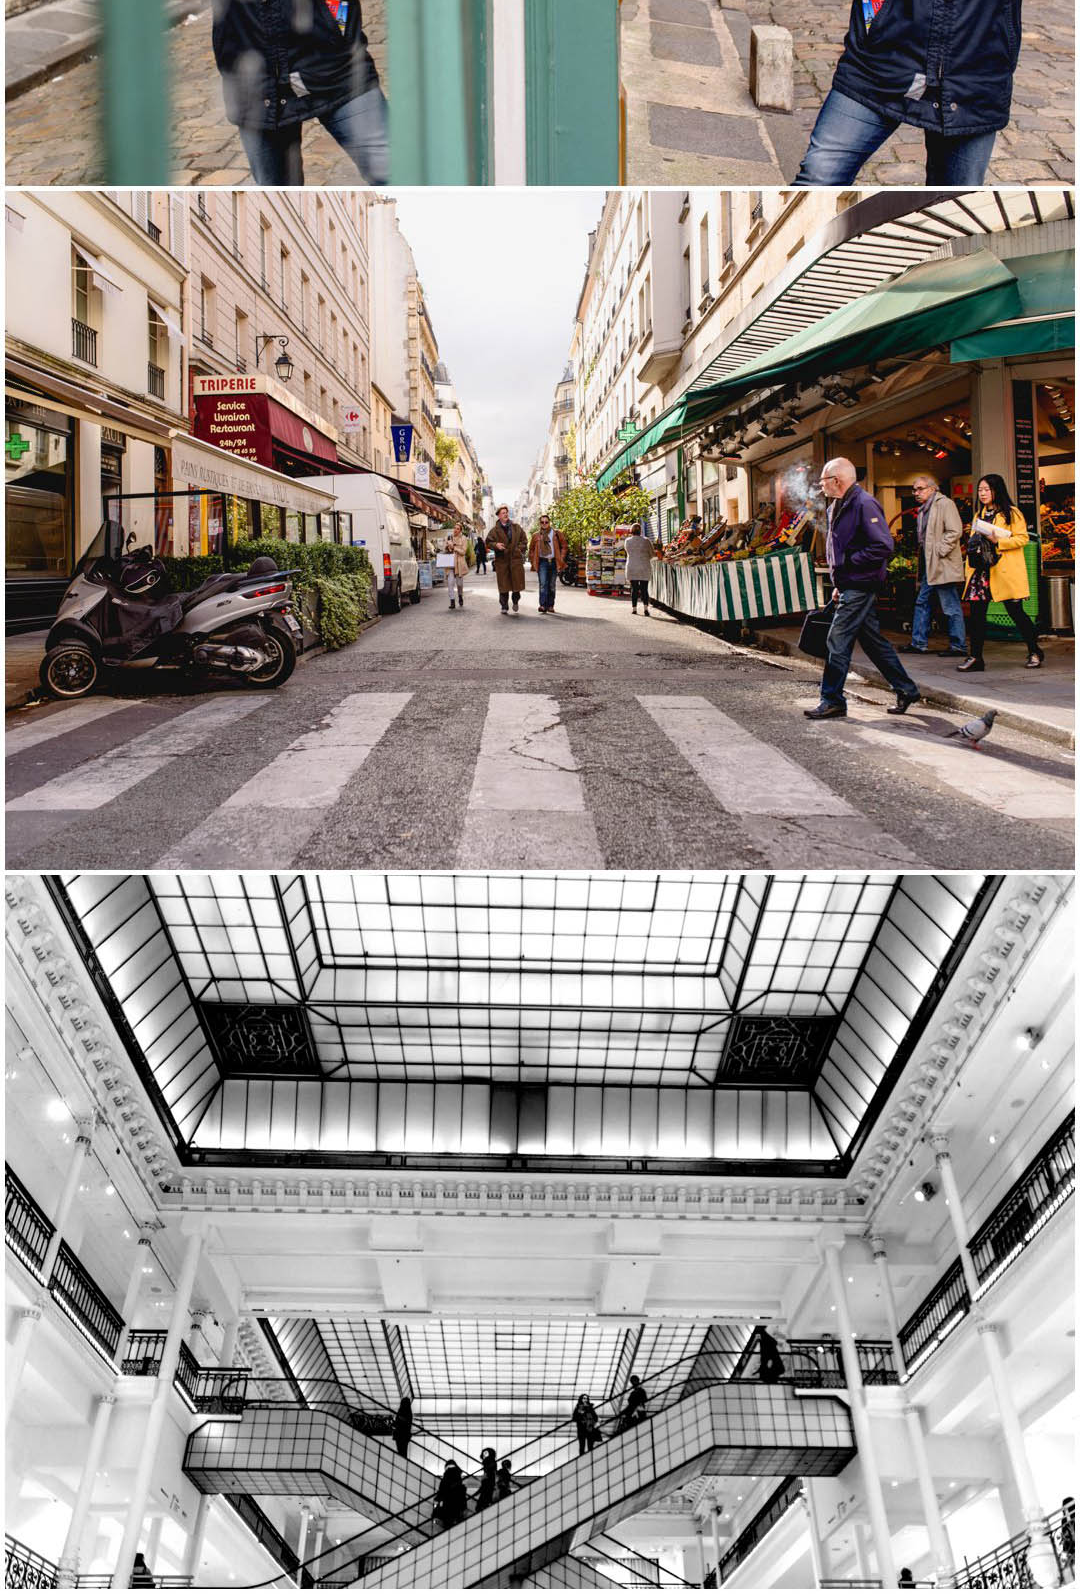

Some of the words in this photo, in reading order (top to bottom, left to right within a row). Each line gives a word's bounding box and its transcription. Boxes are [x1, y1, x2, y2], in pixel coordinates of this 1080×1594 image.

[200, 377, 256, 391] TRIPERIE
[217, 401, 246, 411] Service
[213, 413, 251, 422] Livraison
[210, 423, 256, 433] Restaurant
[219, 438, 247, 448] 24h/24
